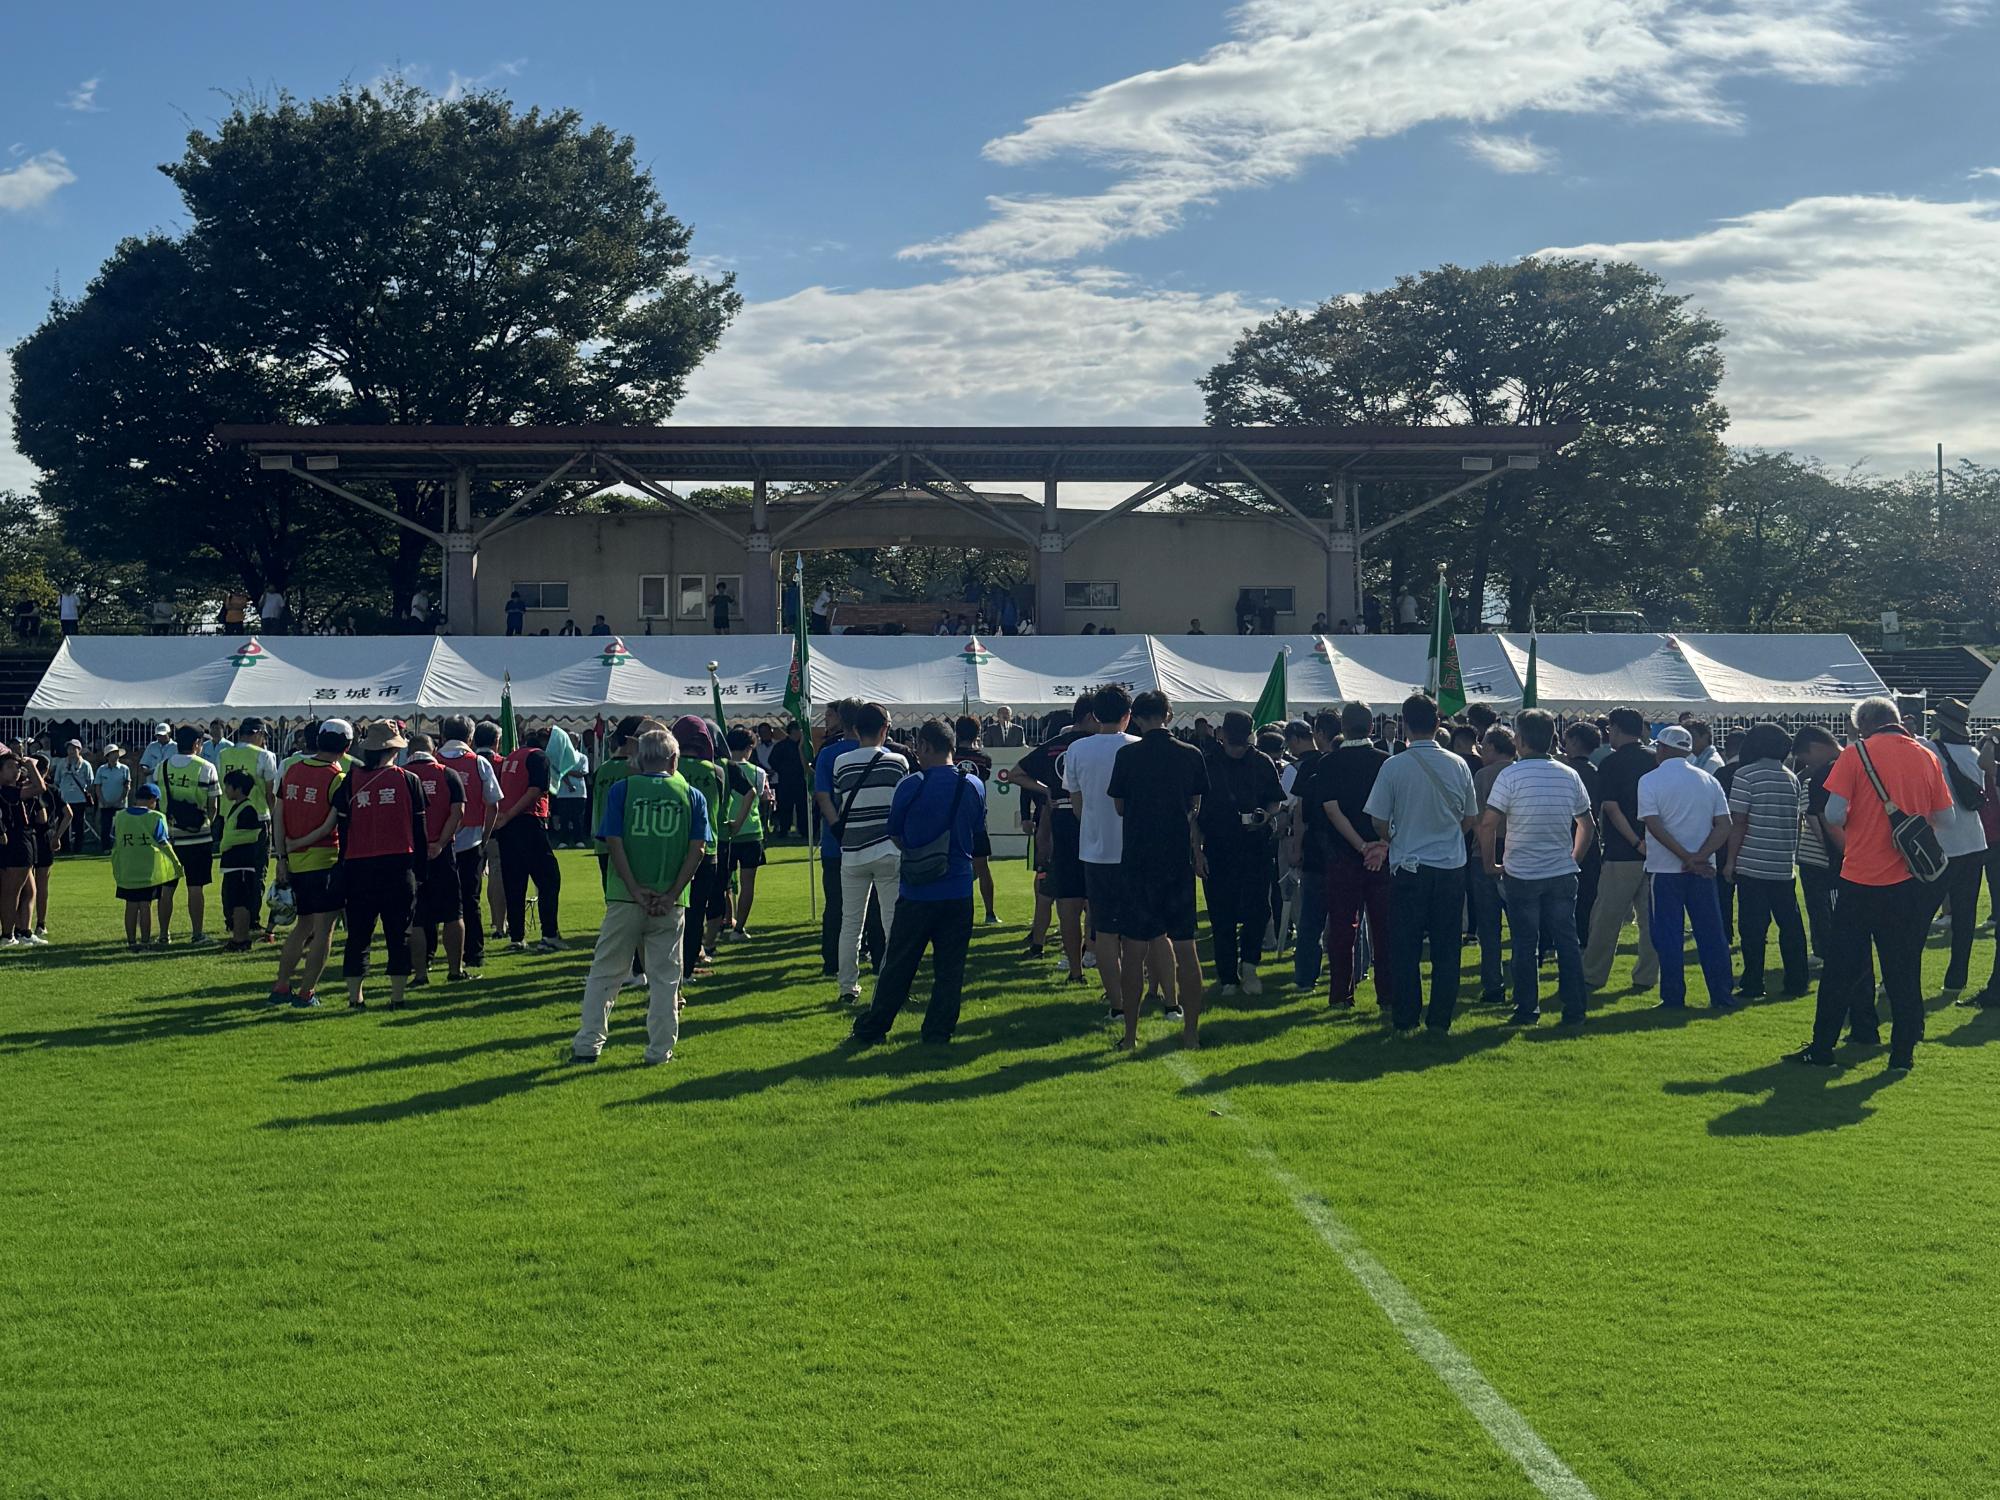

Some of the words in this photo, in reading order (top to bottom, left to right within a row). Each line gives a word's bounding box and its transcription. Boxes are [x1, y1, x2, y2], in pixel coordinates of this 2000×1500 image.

[312, 684, 402, 700] 葛城市
[286, 784, 318, 804] 東室
[357, 788, 396, 808] 東室
[631, 797, 682, 838] 10
